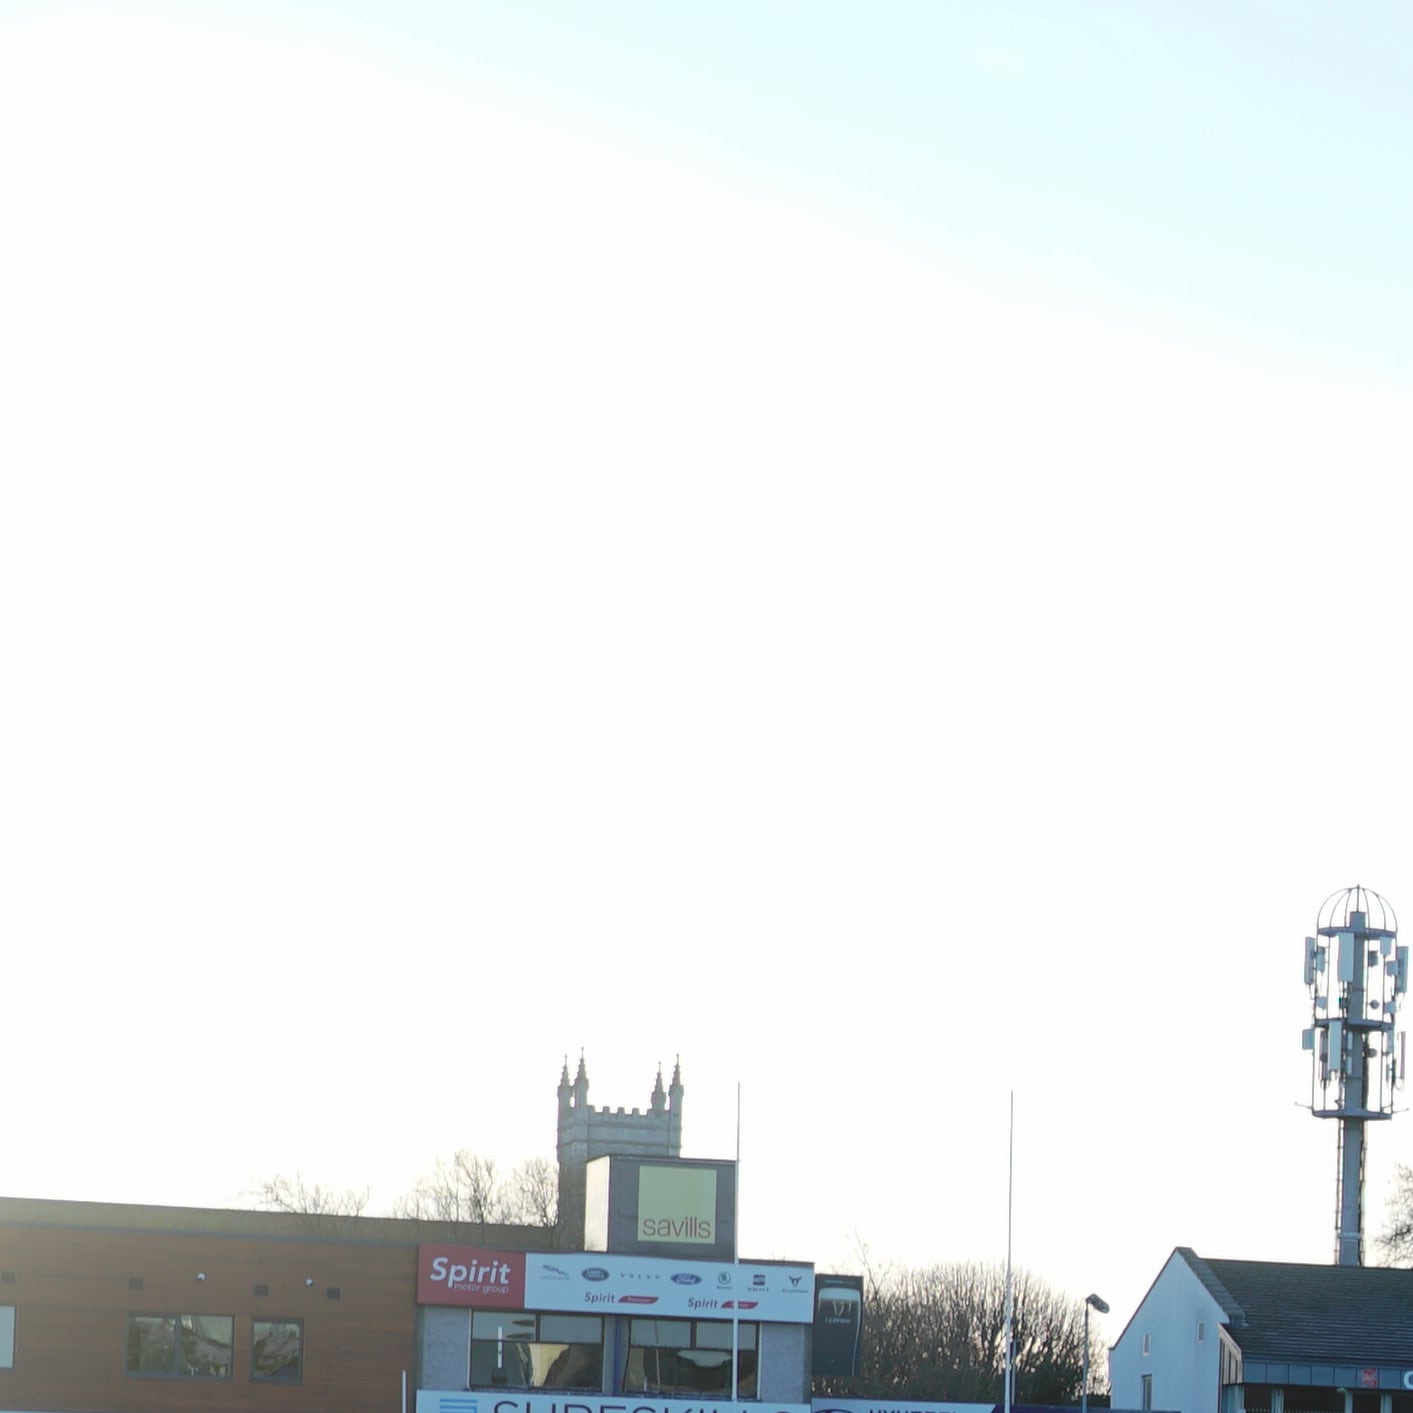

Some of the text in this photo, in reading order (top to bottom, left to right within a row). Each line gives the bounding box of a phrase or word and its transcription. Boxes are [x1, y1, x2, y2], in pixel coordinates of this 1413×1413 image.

[643, 1216, 711, 1239] savills
[430, 1256, 511, 1288] Spirit
[454, 1282, 510, 1294] motor group
[584, 1291, 615, 1304] Spirit
[688, 1296, 719, 1310] Spirit
